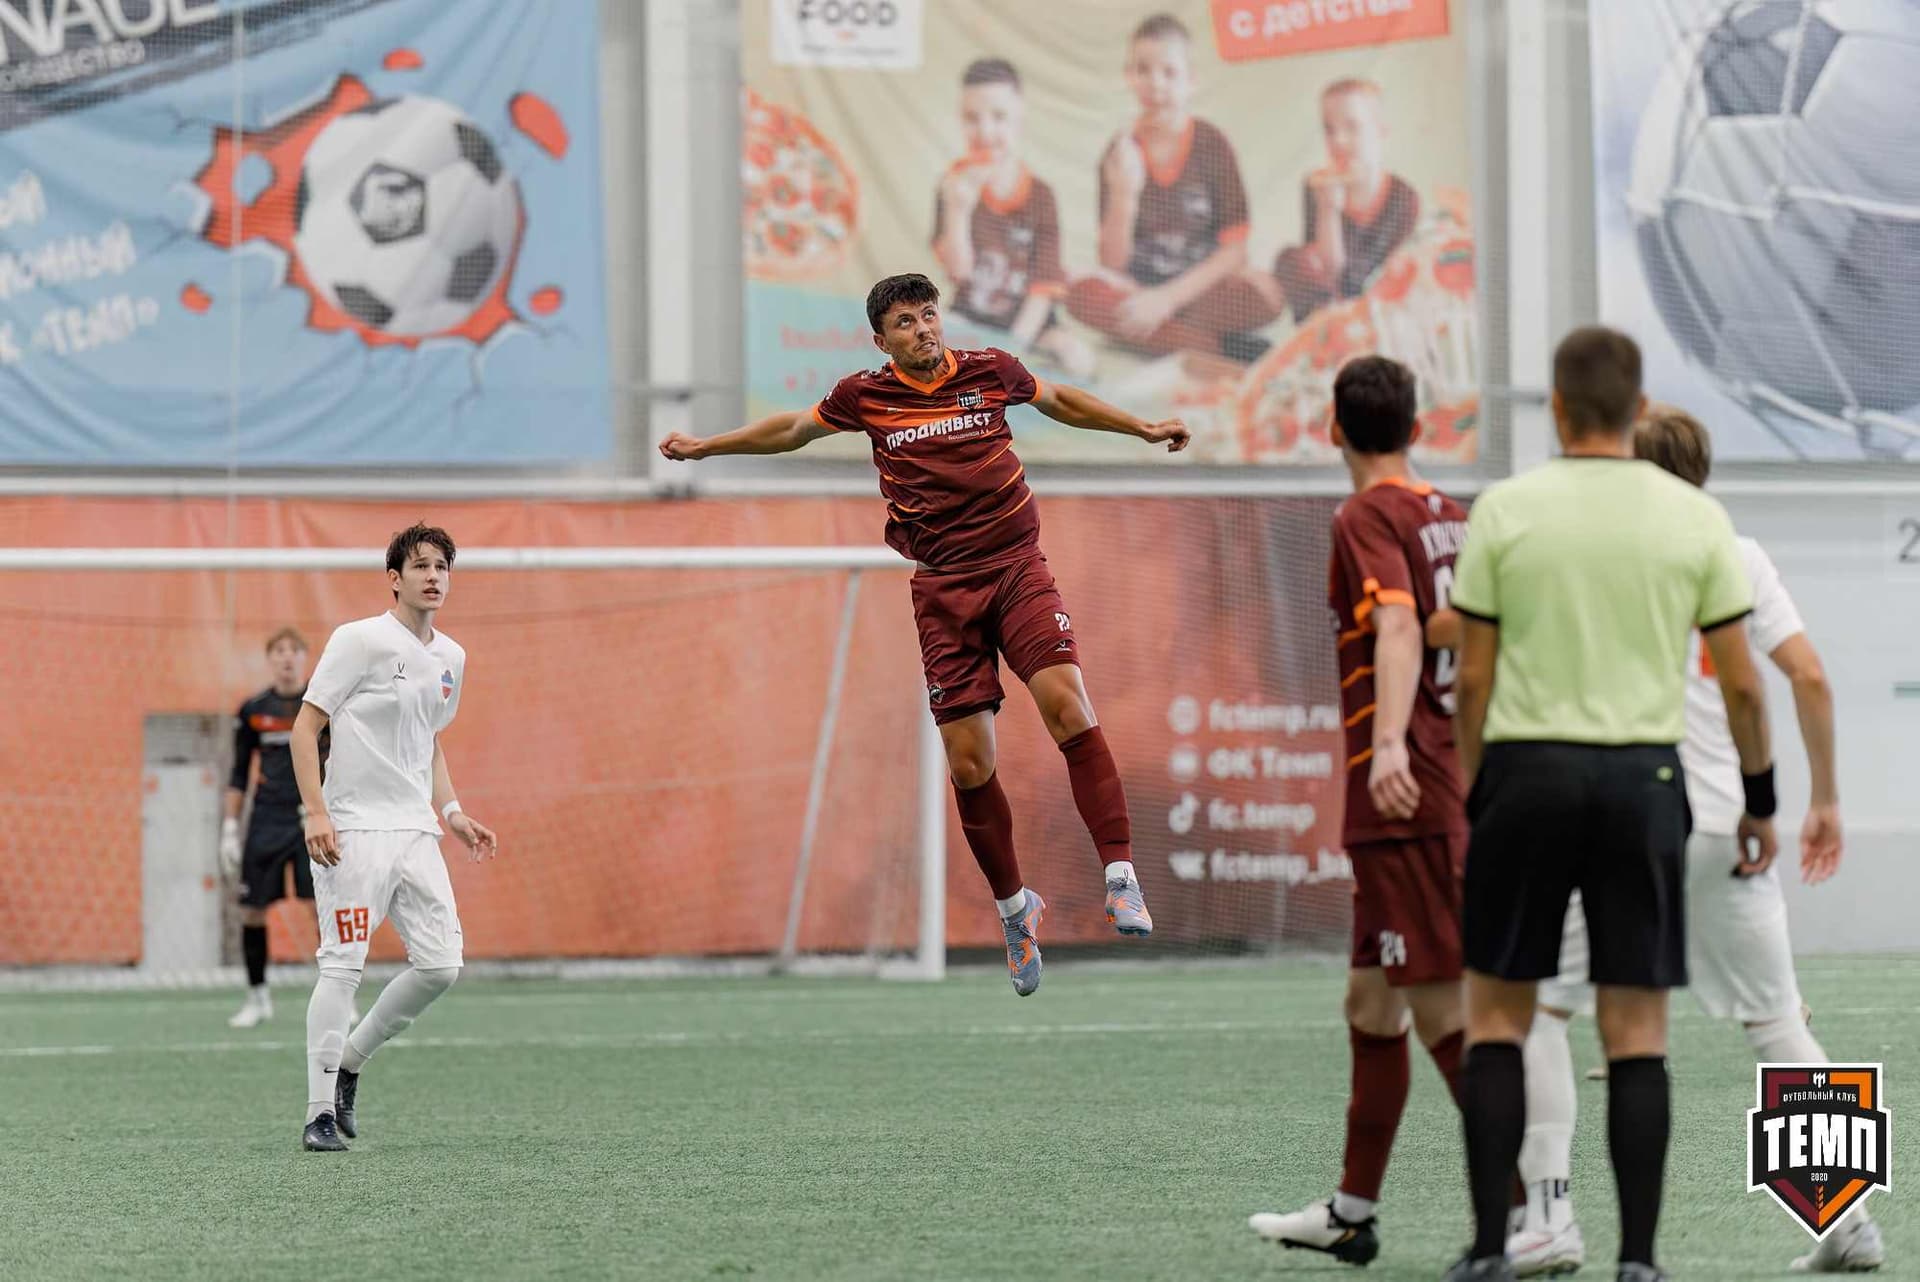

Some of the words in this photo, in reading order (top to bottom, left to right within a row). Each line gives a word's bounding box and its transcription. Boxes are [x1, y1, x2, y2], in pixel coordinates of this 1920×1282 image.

[798, 0, 898, 27] FOOD
[886, 412, 992, 450] ПРОДИНВЕСТ
[335, 907, 368, 944] 69
